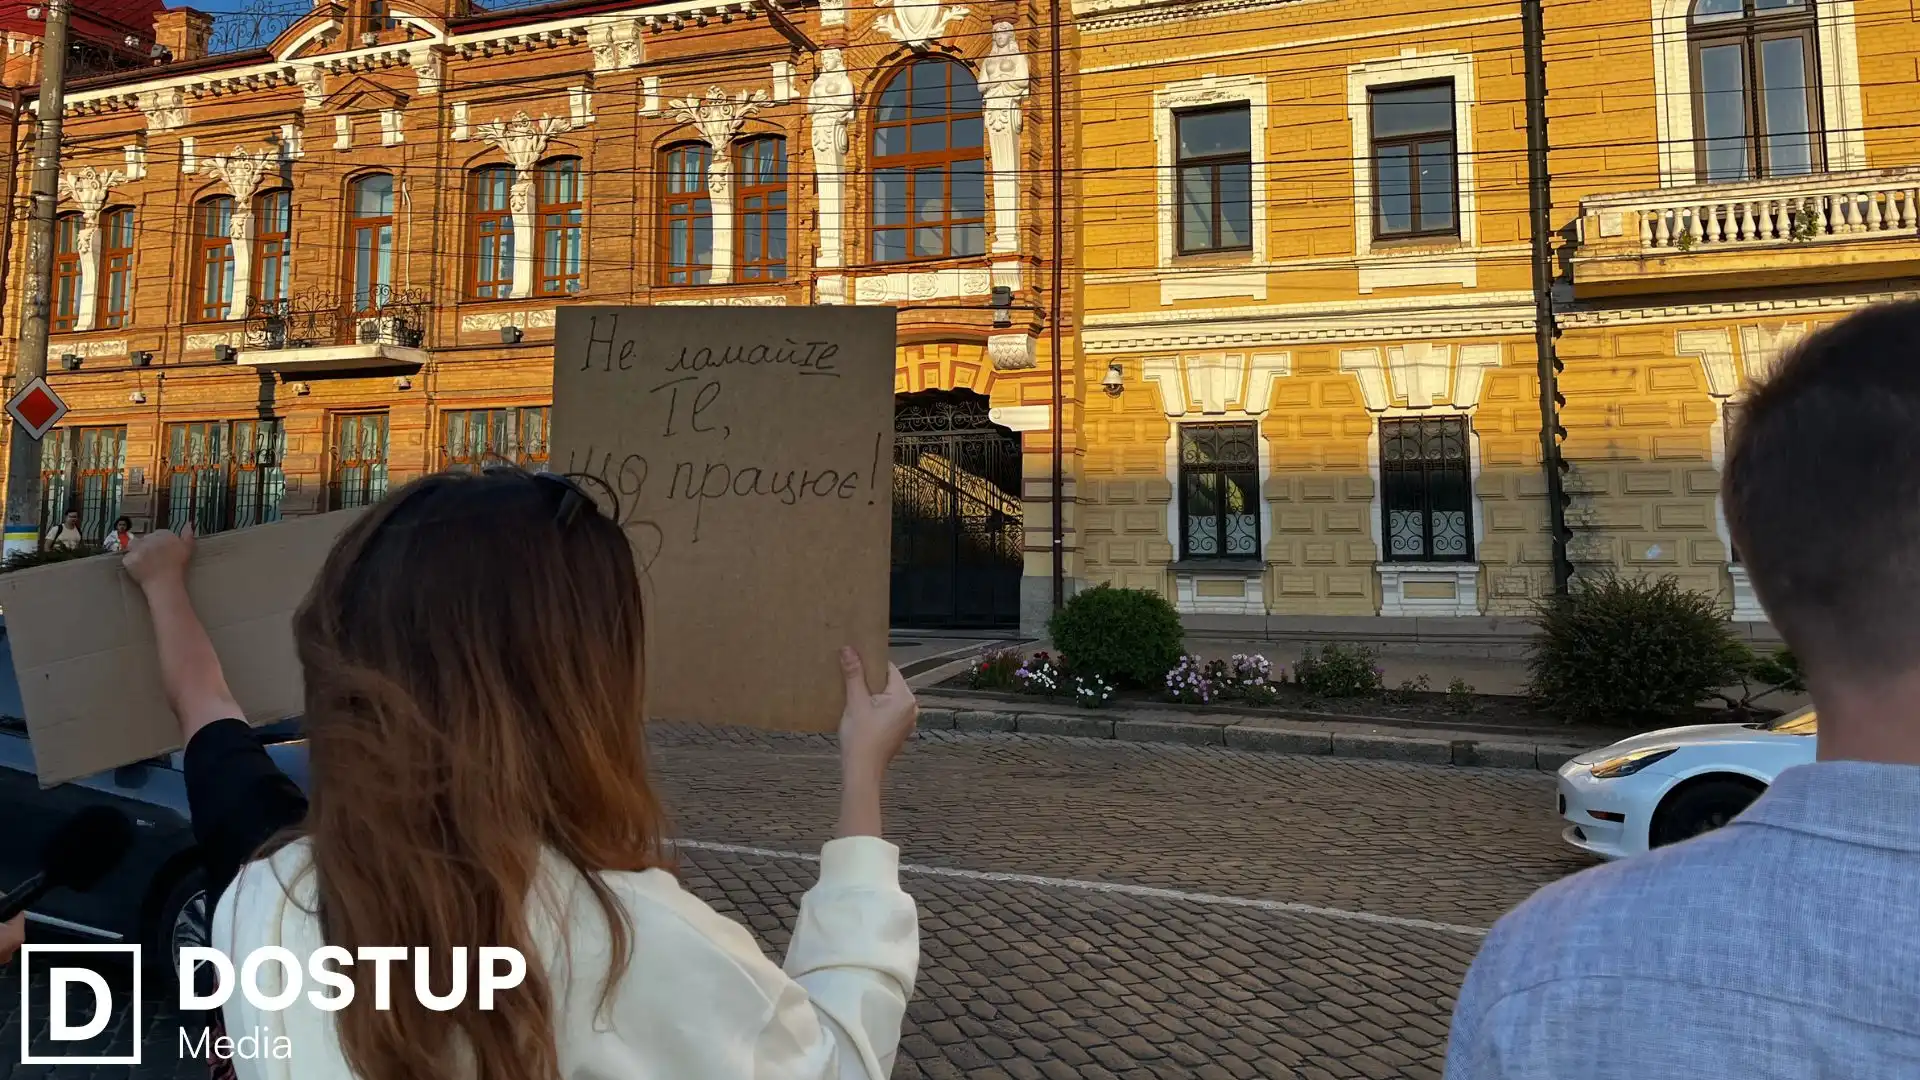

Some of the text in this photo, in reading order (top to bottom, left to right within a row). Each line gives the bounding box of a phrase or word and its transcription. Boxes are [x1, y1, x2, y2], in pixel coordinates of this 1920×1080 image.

[580, 313, 839, 372] Не ламайте
[667, 432, 882, 544] працює!
